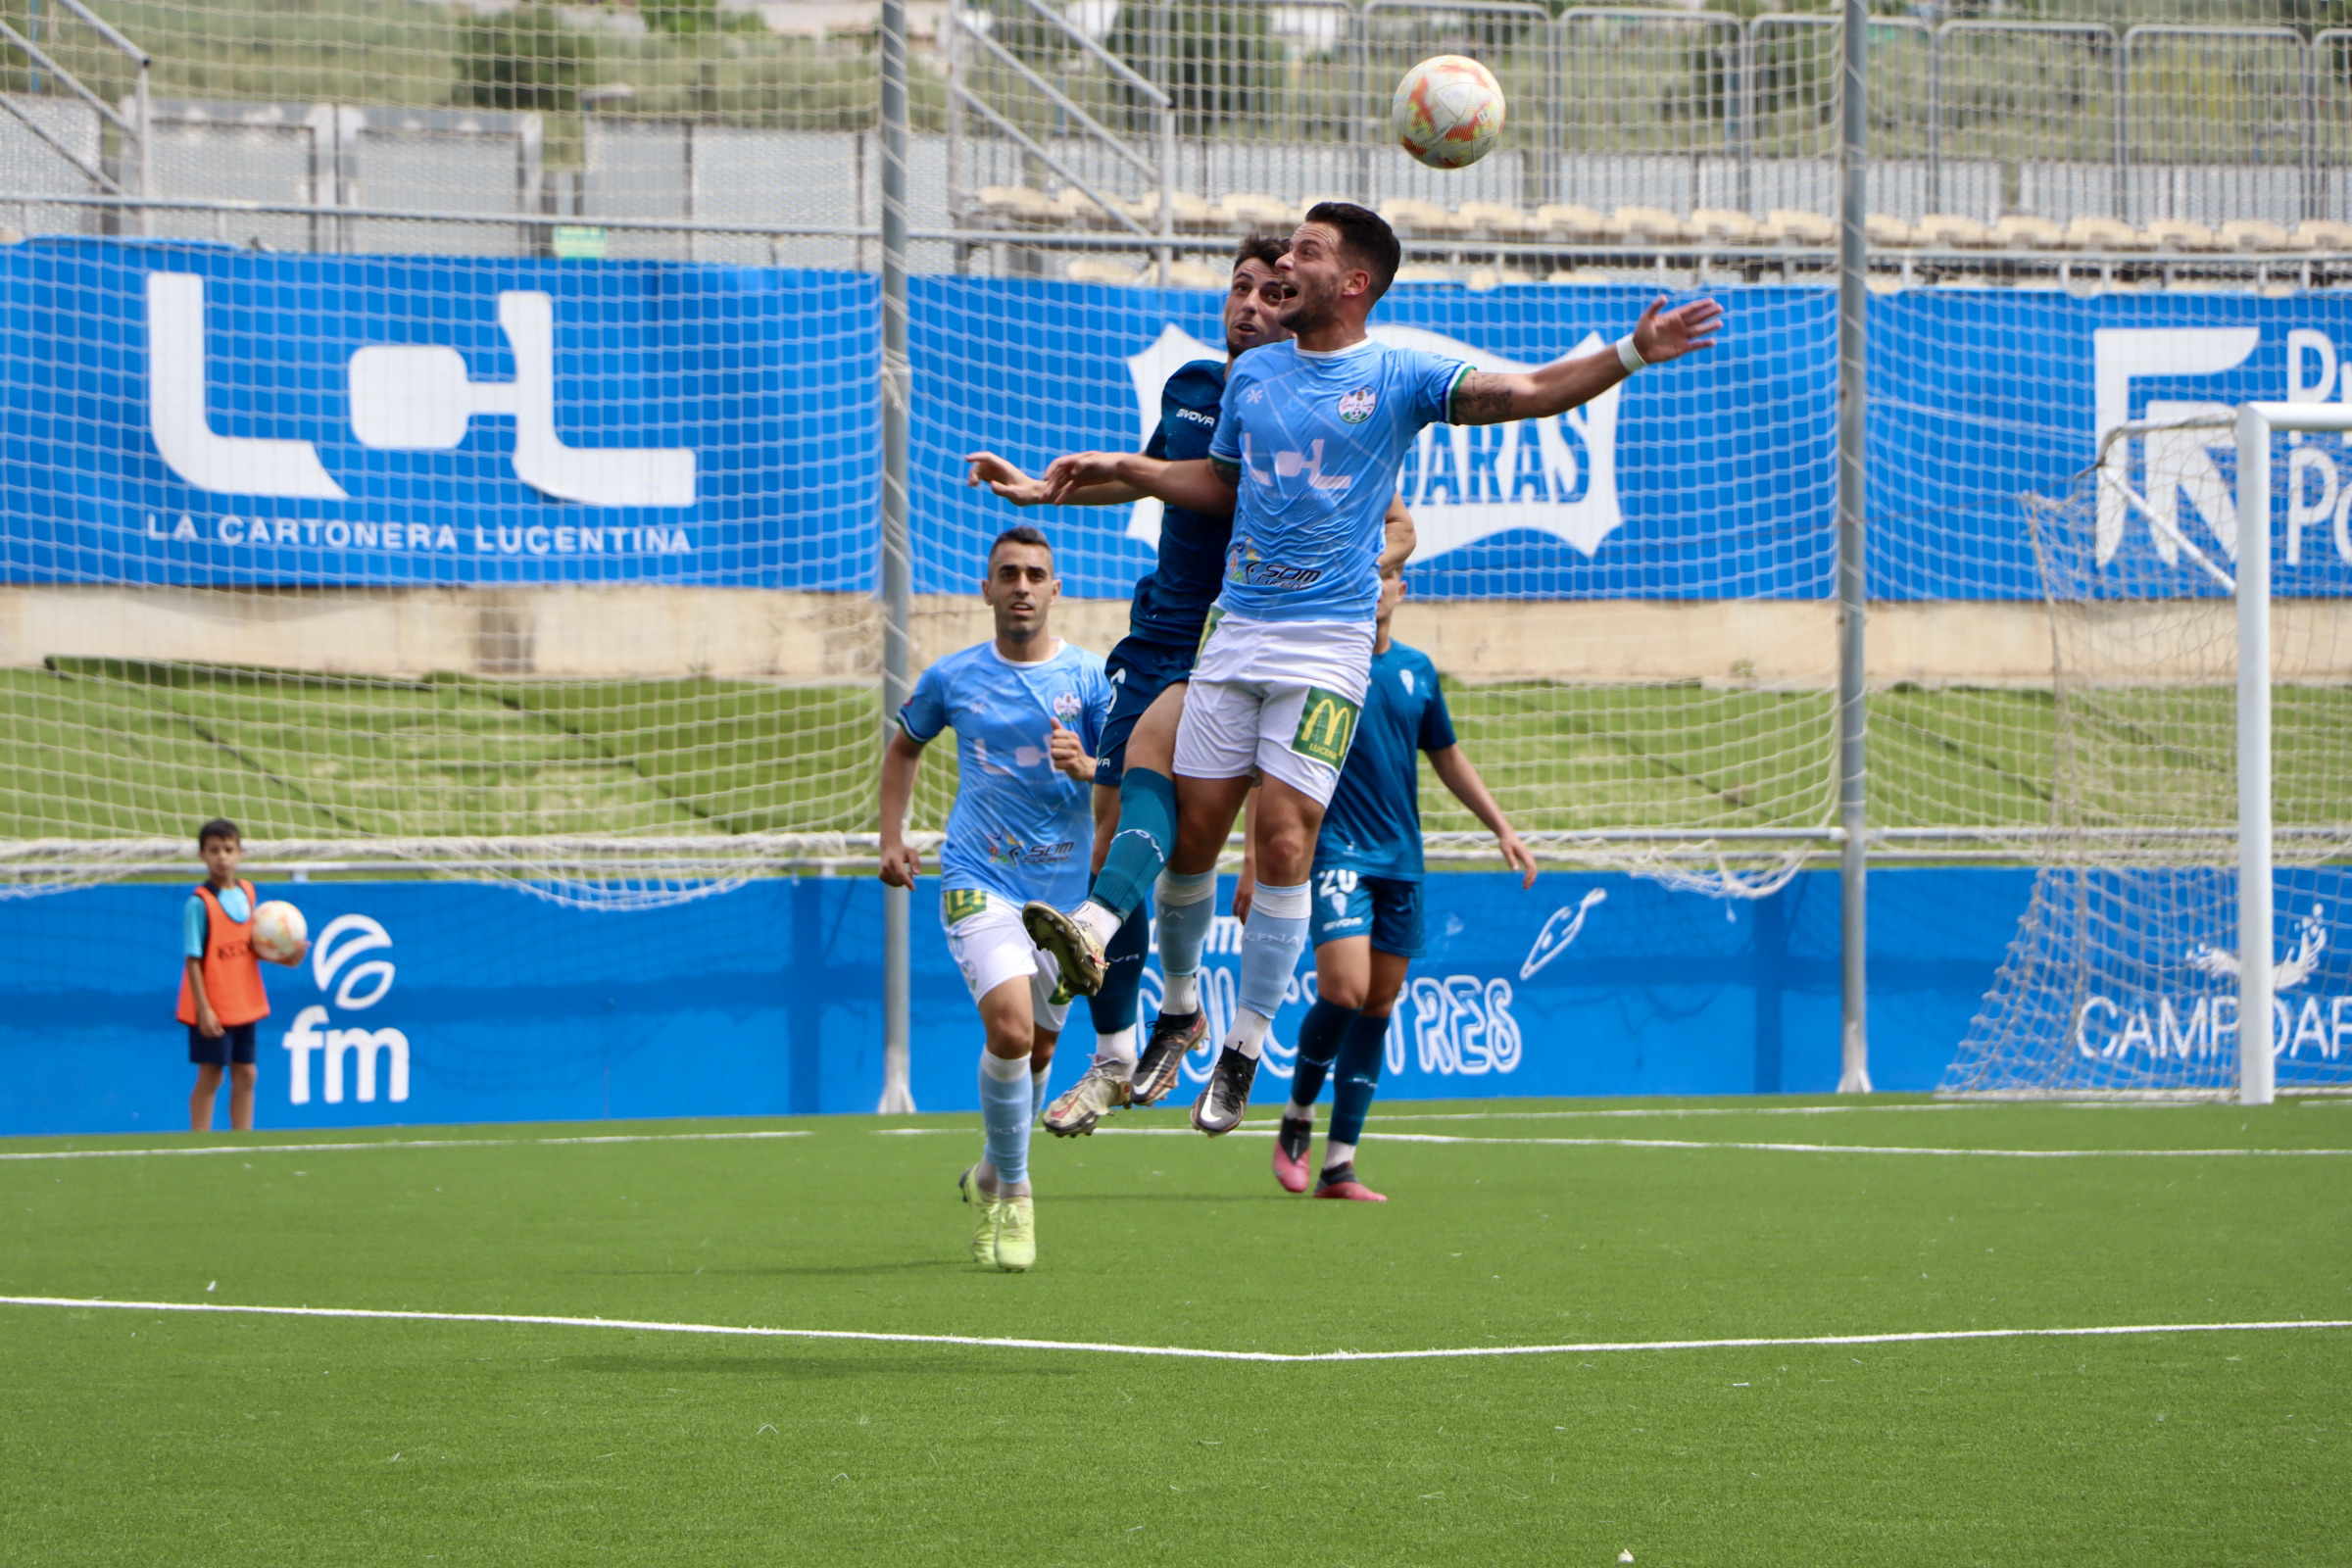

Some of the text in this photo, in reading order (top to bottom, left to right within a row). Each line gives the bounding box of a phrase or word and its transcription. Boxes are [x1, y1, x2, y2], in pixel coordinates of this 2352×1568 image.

[147, 513, 693, 556] LA CARTONERA LUCENTINA
[282, 1004, 410, 1105] fm
